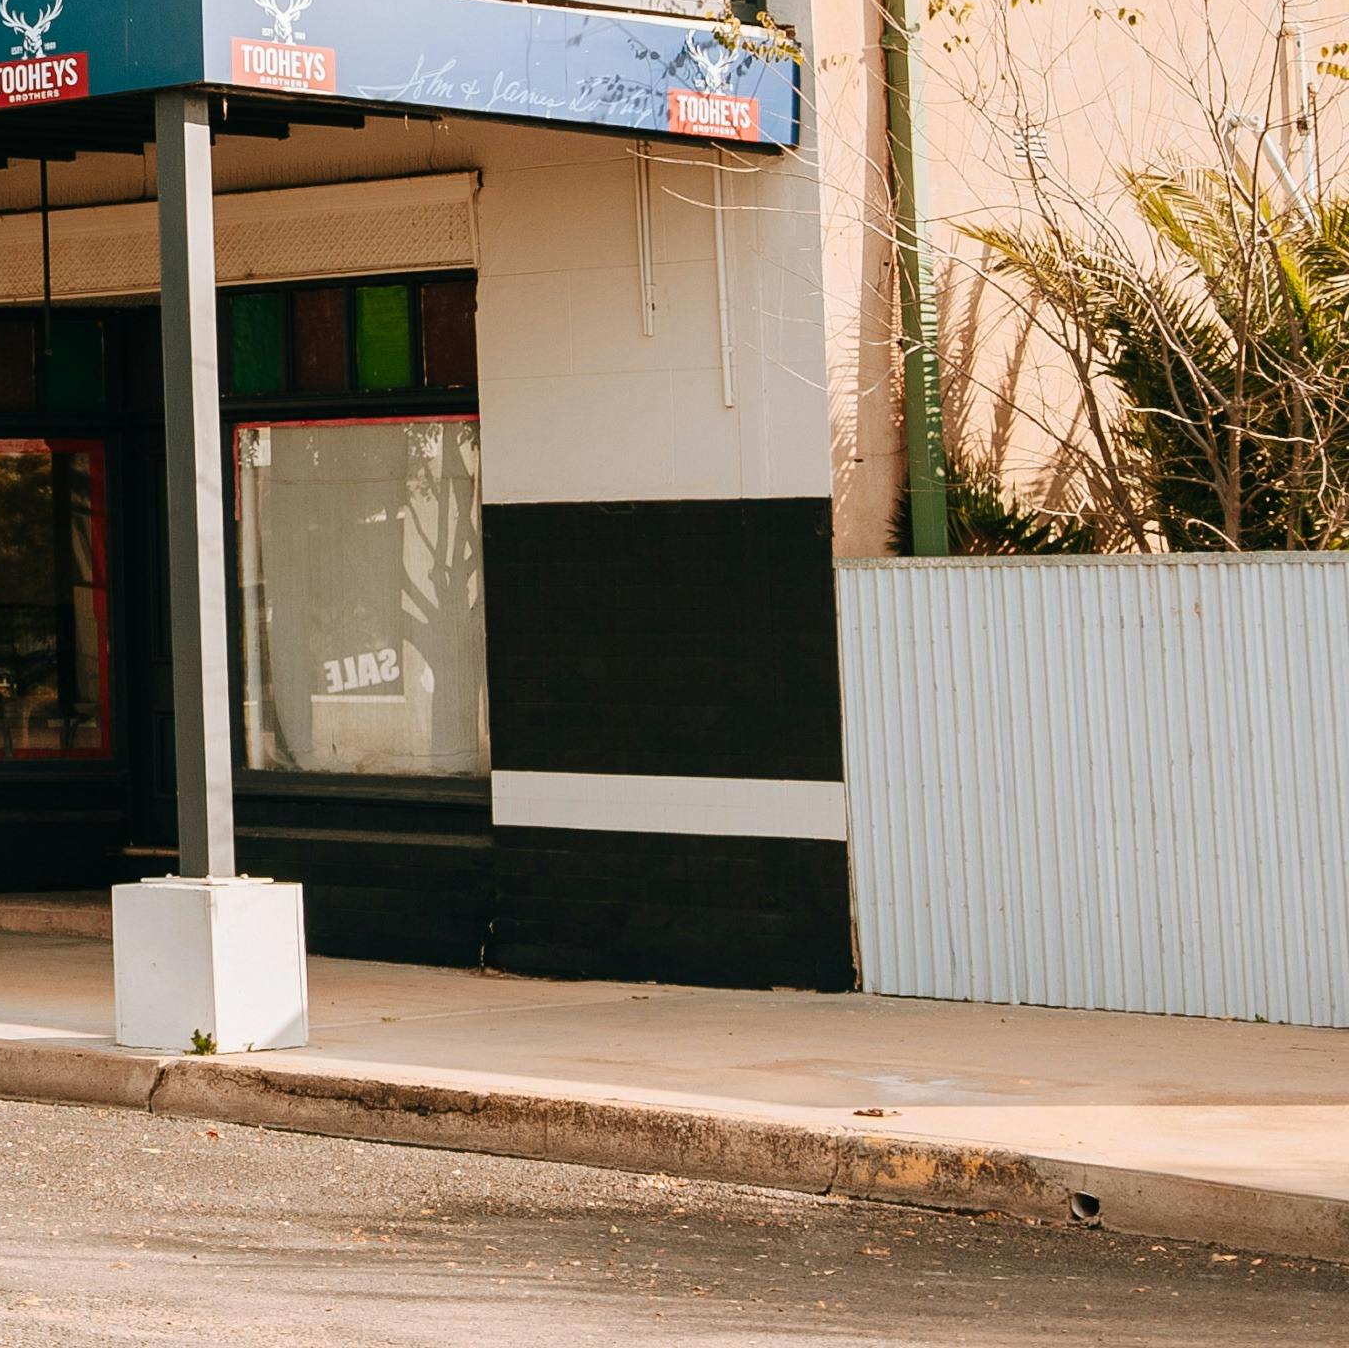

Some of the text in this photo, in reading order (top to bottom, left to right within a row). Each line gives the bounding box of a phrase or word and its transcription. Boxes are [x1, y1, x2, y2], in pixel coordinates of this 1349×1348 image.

[240, 43, 326, 82] TOOHEYS
[8, 88, 61, 103] BROTHERS
[676, 94, 751, 129] TOOHEYS
